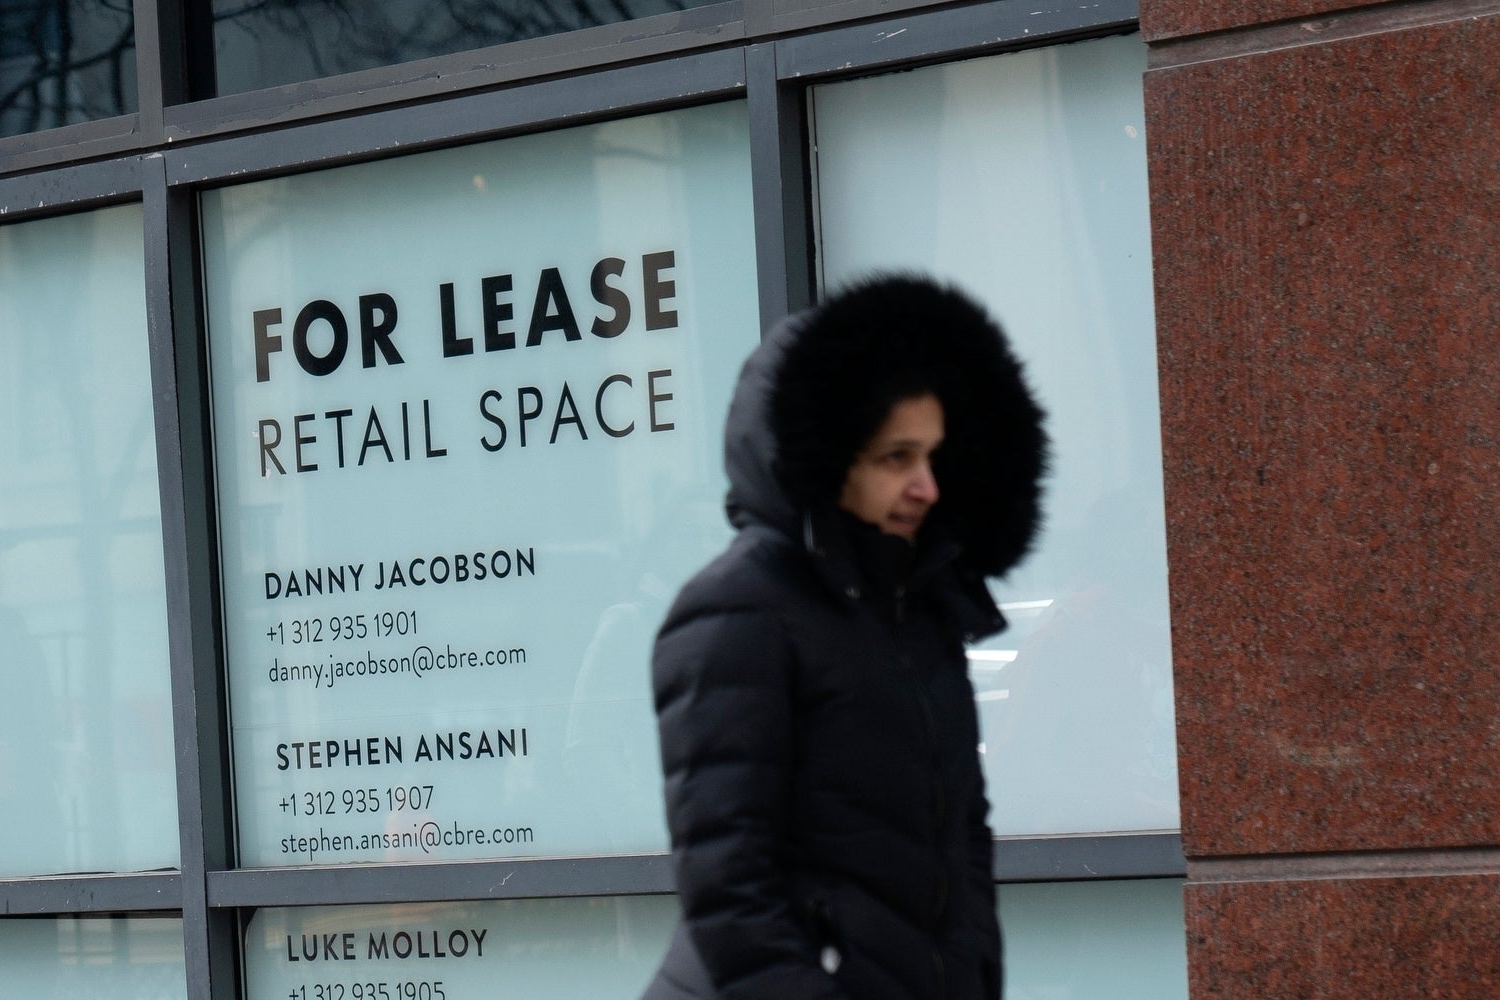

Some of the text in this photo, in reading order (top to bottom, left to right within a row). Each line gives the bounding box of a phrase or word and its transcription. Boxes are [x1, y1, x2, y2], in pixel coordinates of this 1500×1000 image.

[252, 249, 679, 383] FOR LEASE
[257, 368, 676, 478] RETAIL SPACE
[264, 547, 536, 600] DANNY JACOBSON
[266, 609, 417, 646] +1 312 935 1901
[268, 644, 527, 690] danny.jacobson@cbre.com
[276, 727, 529, 771] STEPHEN ANSANI
[278, 785, 434, 817] +1 312 935 1907
[280, 820, 534, 862] stephen.ansani@cbre.com
[287, 928, 488, 962] LUKE MOLLOY
